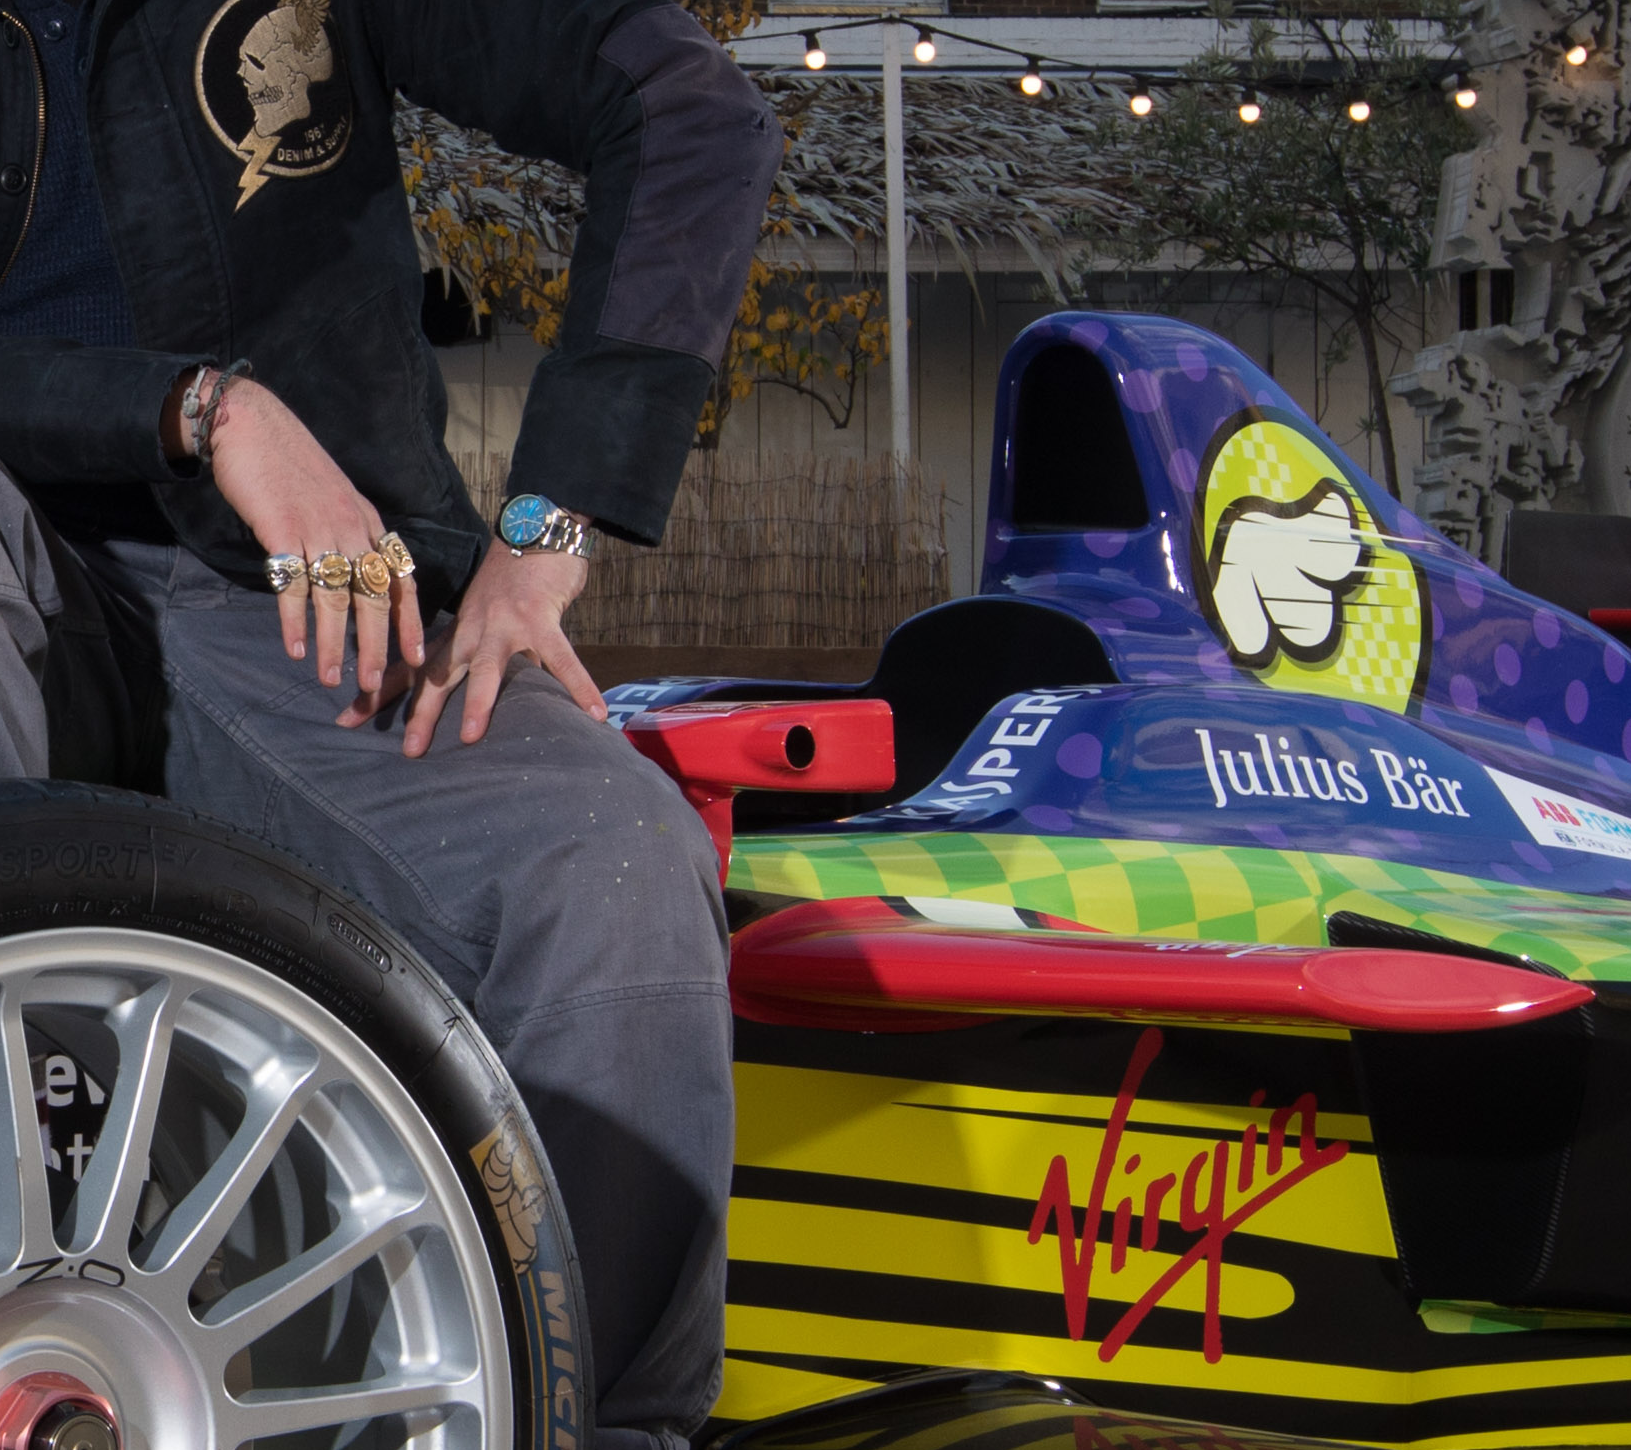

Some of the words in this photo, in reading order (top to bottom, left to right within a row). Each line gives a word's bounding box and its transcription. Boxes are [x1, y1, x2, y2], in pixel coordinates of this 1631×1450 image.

[277, 147, 314, 162] DENIM
[315, 145, 327, 158] &
[1192, 727, 1366, 809] Julius
[1383, 747, 1472, 820] Bär
[1532, 796, 1581, 827] ABB
[1028, 1027, 1349, 1363] Virgin
